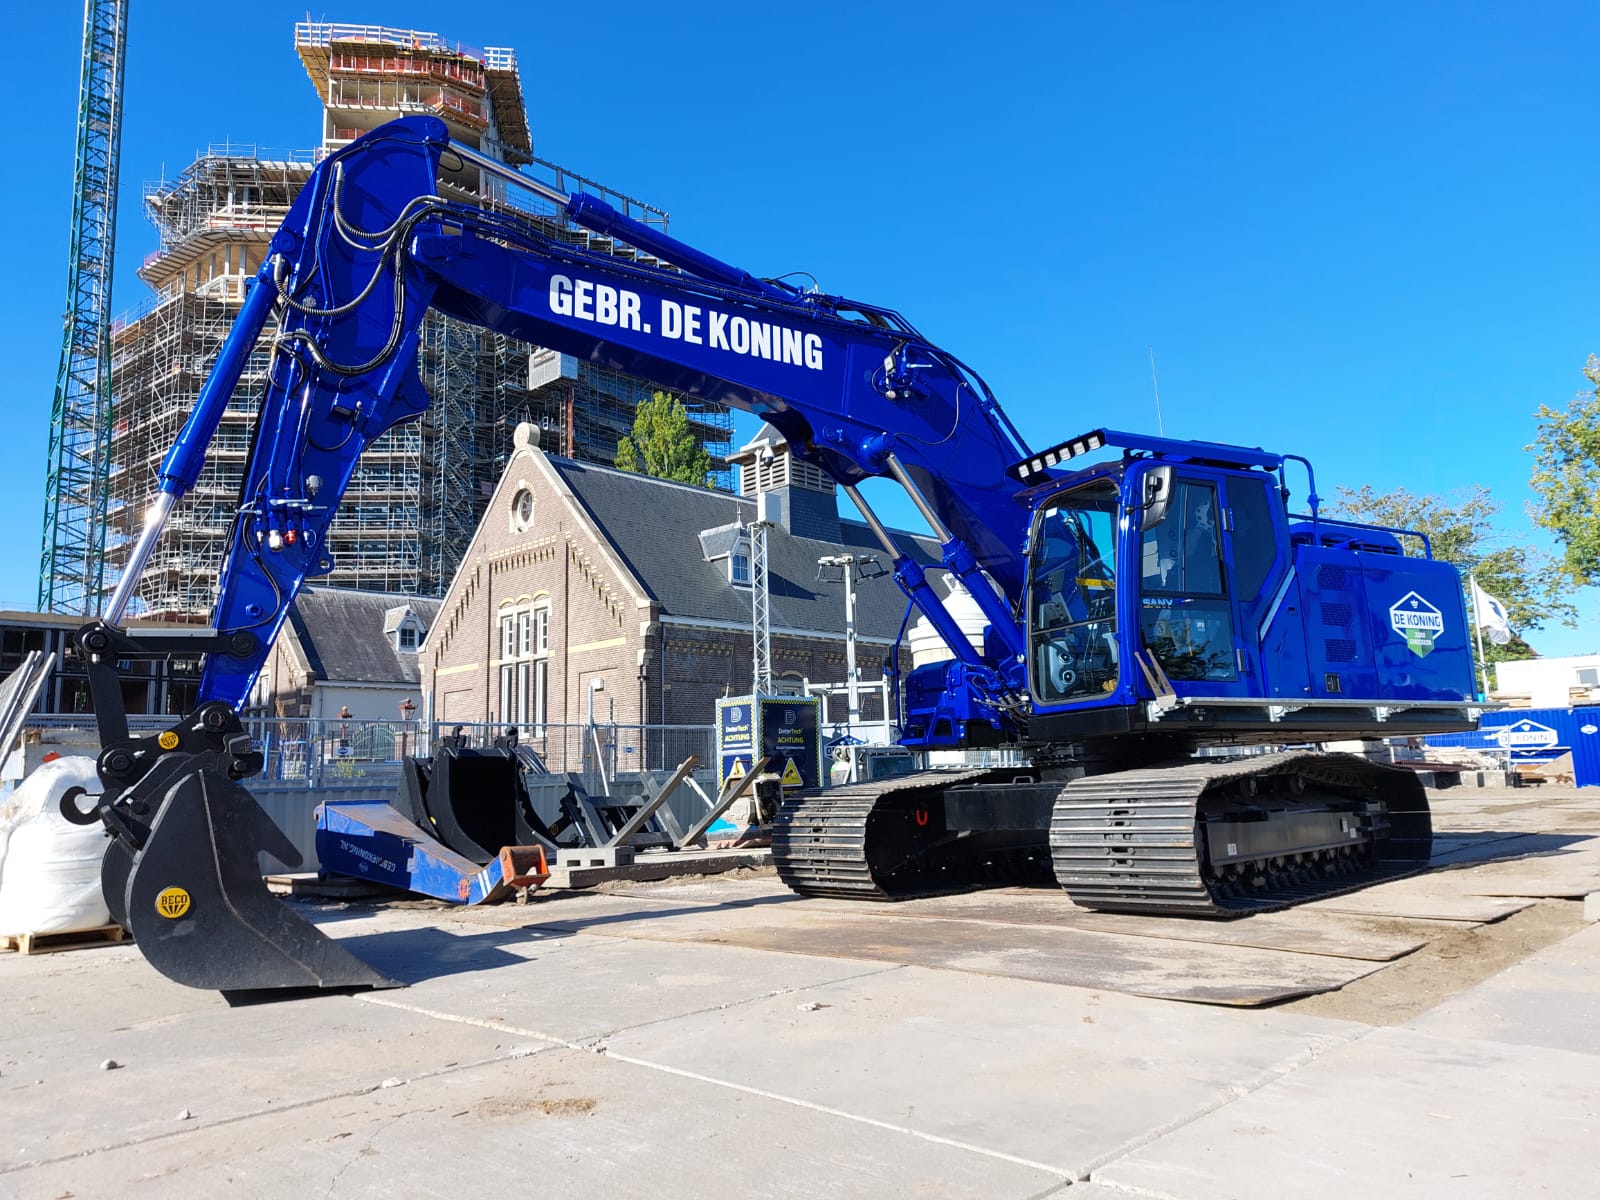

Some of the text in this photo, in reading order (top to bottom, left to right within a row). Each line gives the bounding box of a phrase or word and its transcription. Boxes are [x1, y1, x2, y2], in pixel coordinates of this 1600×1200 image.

[549, 274, 823, 371] GEBR. DE KONING
[1393, 613, 1441, 627] DE KONING
[725, 733, 750, 742] ACHTUNG
[1515, 733, 1555, 742] KONING
[161, 894, 188, 905] BECO
